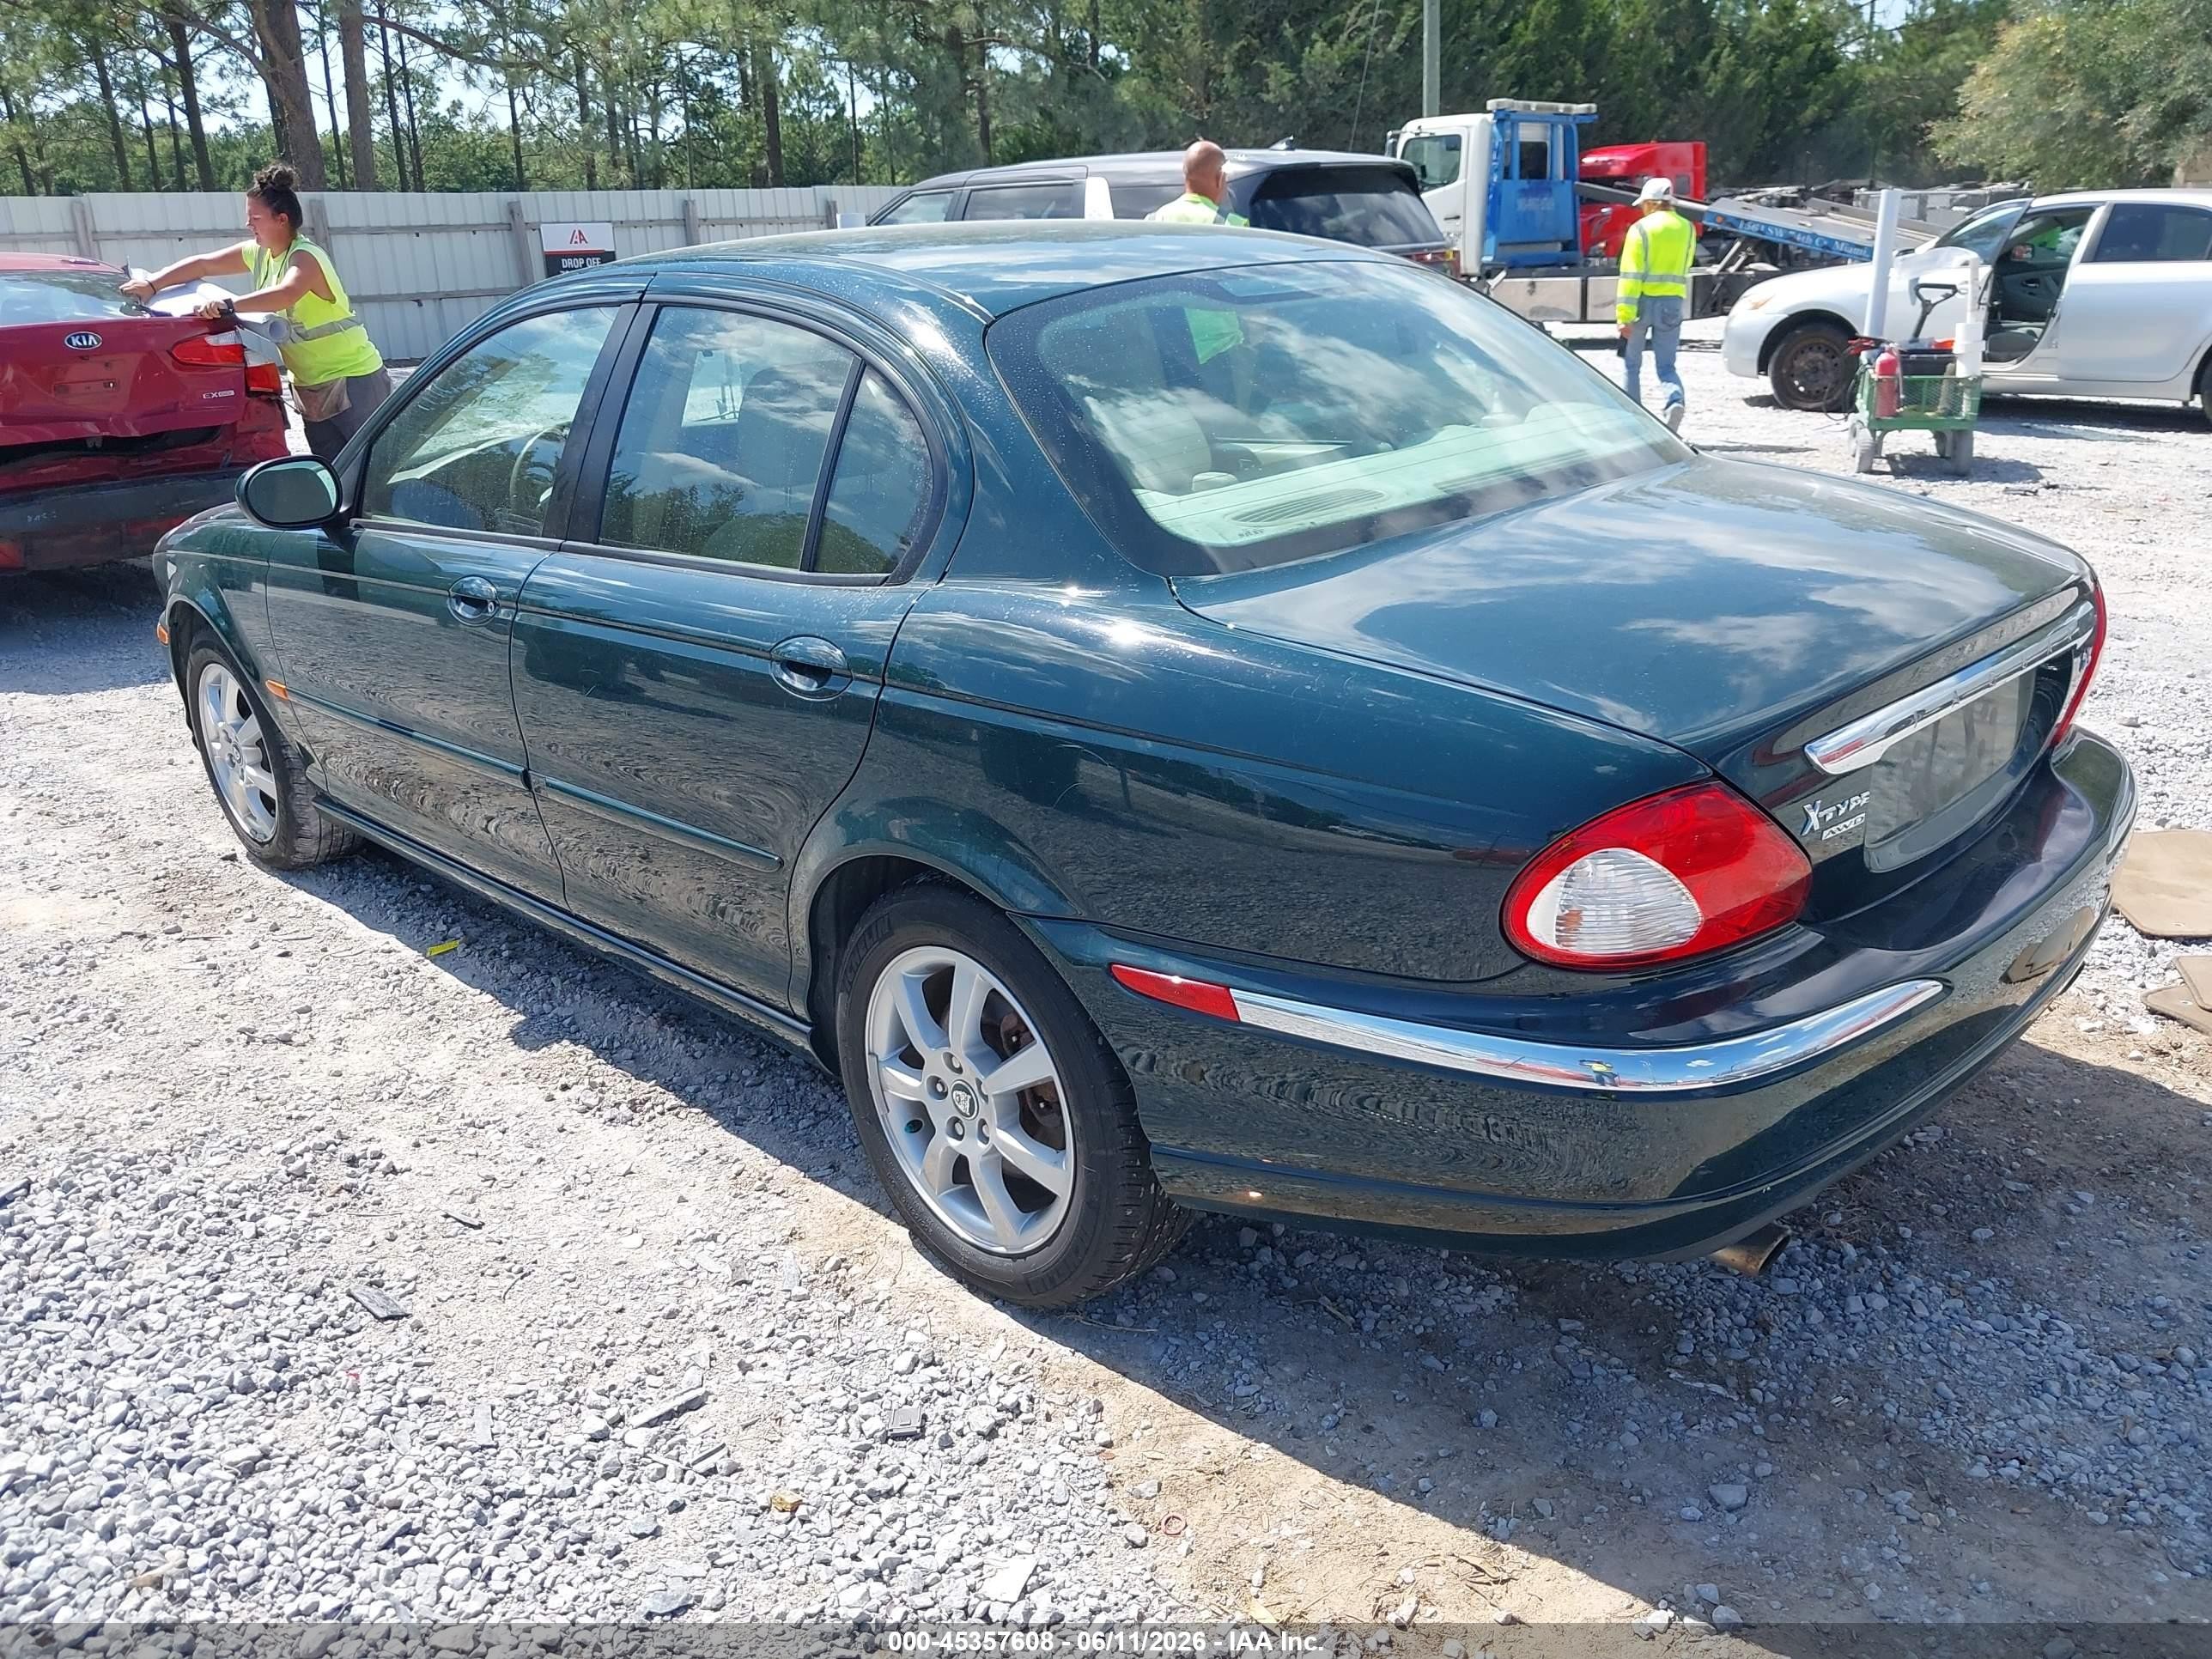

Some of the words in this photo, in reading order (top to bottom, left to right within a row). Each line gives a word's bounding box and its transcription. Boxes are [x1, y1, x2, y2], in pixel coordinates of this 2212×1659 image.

[561, 258, 585, 269] DROP
[586, 257, 602, 268] OFF
[70, 334, 99, 348] KIA
[1822, 813, 1866, 840] AWD
